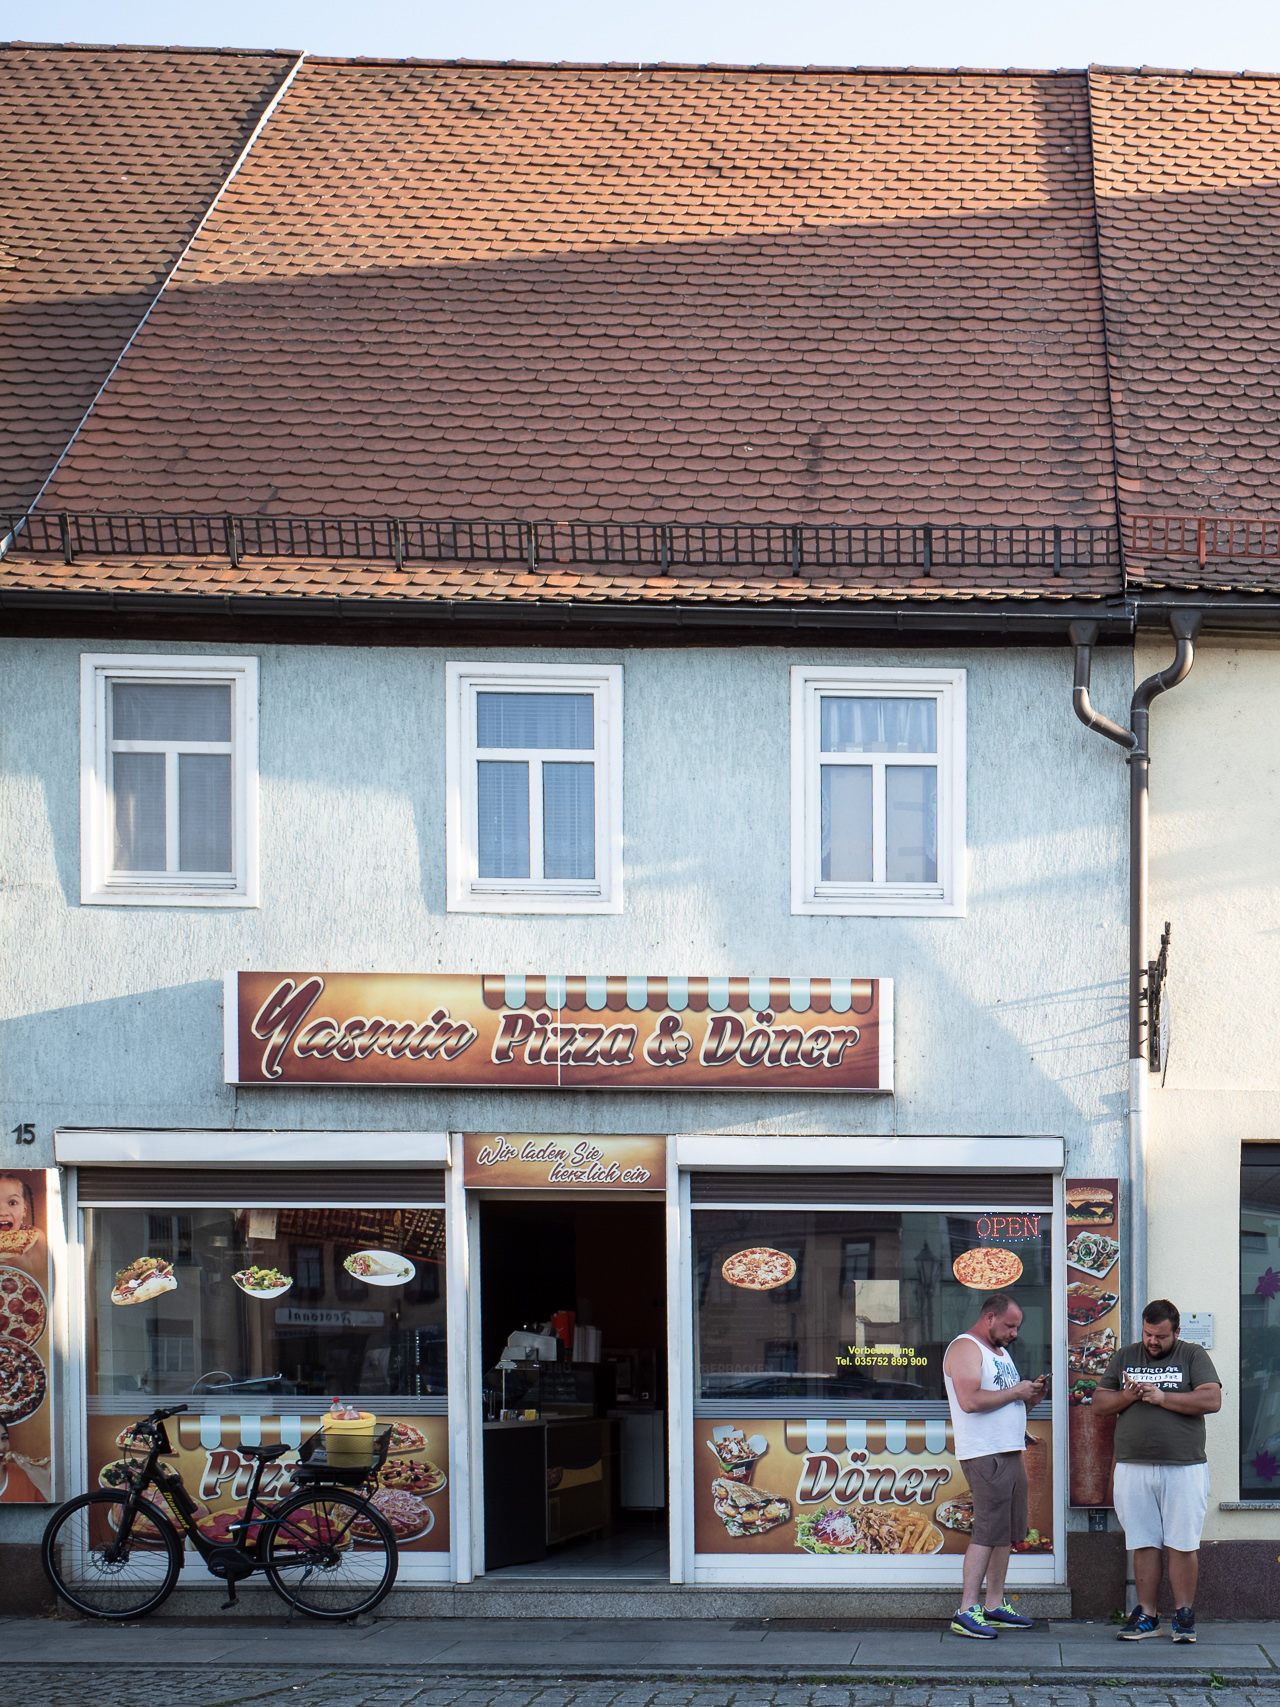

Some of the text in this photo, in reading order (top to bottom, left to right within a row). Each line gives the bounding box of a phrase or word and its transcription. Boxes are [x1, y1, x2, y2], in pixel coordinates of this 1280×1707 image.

[252, 976, 860, 1078] Yasmin Pizza & Döner
[11, 1123, 36, 1144] 15
[477, 1136, 603, 1166] Wir laden Sie
[548, 1160, 651, 1183] herzlich ein
[976, 1217, 1040, 1236] OPEN
[835, 1357, 927, 1365] Tel. 035752 899 900
[848, 1346, 914, 1356] Vorbestellung
[199, 1450, 302, 1500] Pizz
[796, 1448, 952, 1506] Döner
[163, 1492, 190, 1529] Diamant
